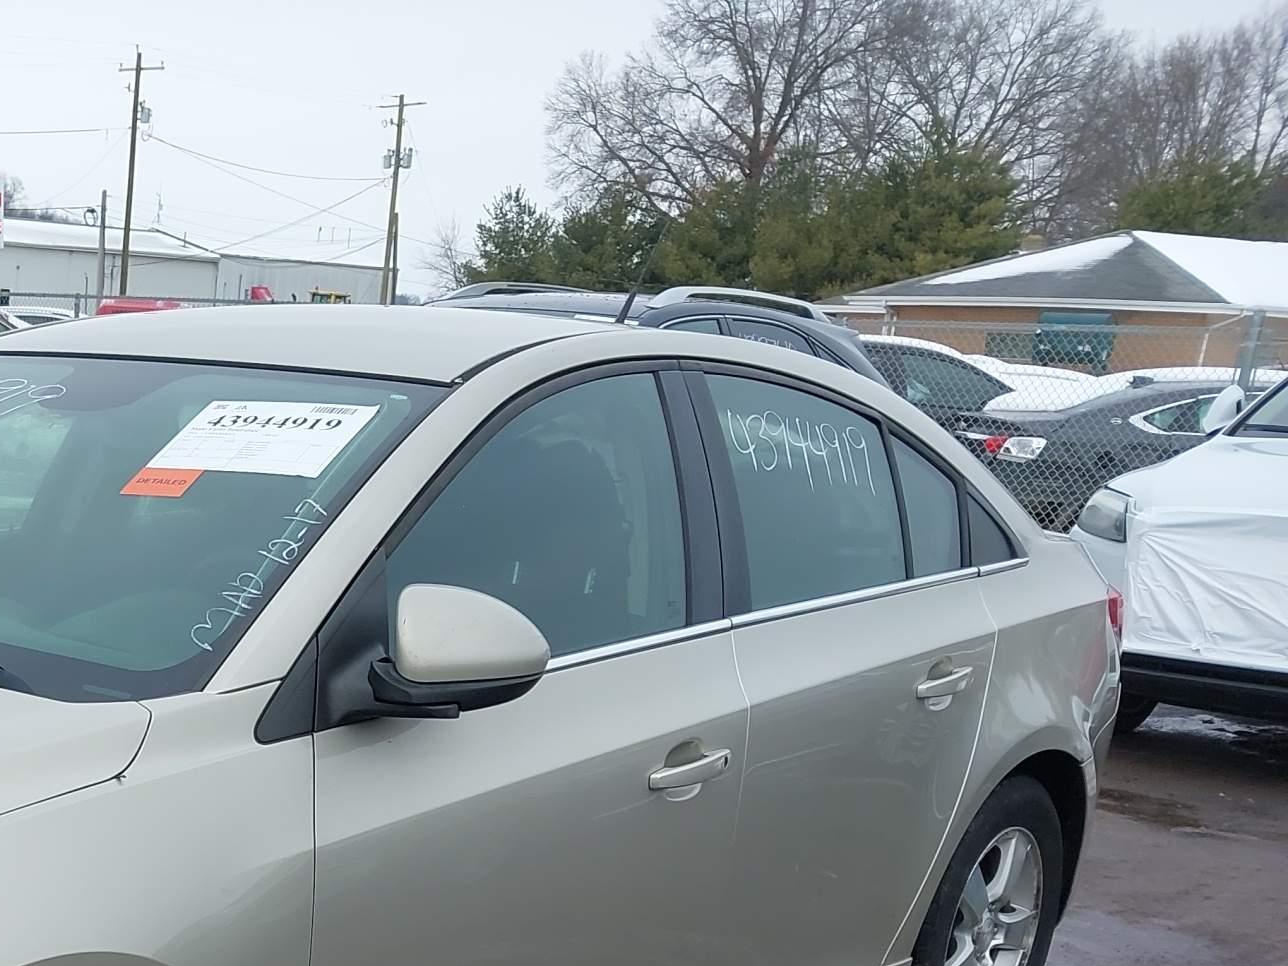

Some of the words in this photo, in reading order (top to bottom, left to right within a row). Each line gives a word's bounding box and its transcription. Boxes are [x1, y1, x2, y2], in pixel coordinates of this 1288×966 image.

[207, 414, 343, 431] 43944919
[727, 409, 876, 496] 43944919
[136, 476, 187, 487] DETAILED
[258, 499, 328, 565] 12-17
